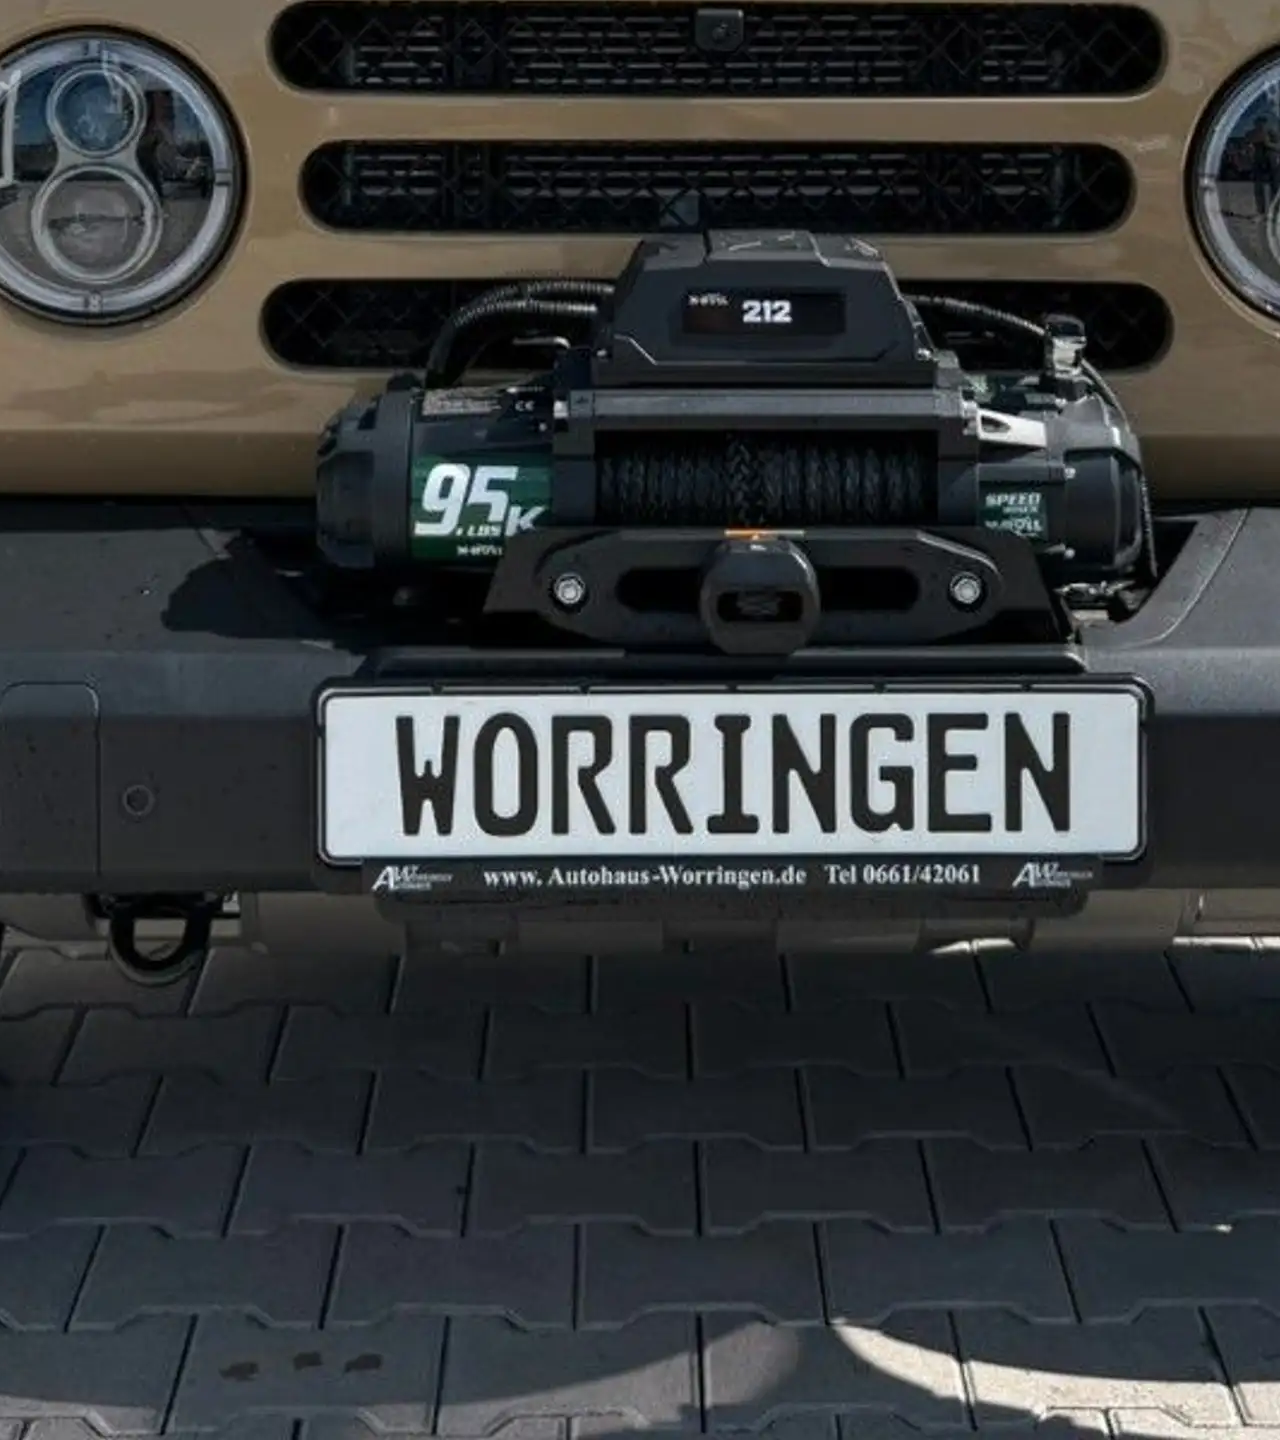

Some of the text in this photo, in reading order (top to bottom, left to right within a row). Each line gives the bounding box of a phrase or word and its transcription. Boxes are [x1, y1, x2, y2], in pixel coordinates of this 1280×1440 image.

[742, 299, 793, 324] 212
[395, 710, 1072, 838] WORRINGEN
[824, 864, 857, 885] Tel
[863, 863, 980, 887] 0661/42061
